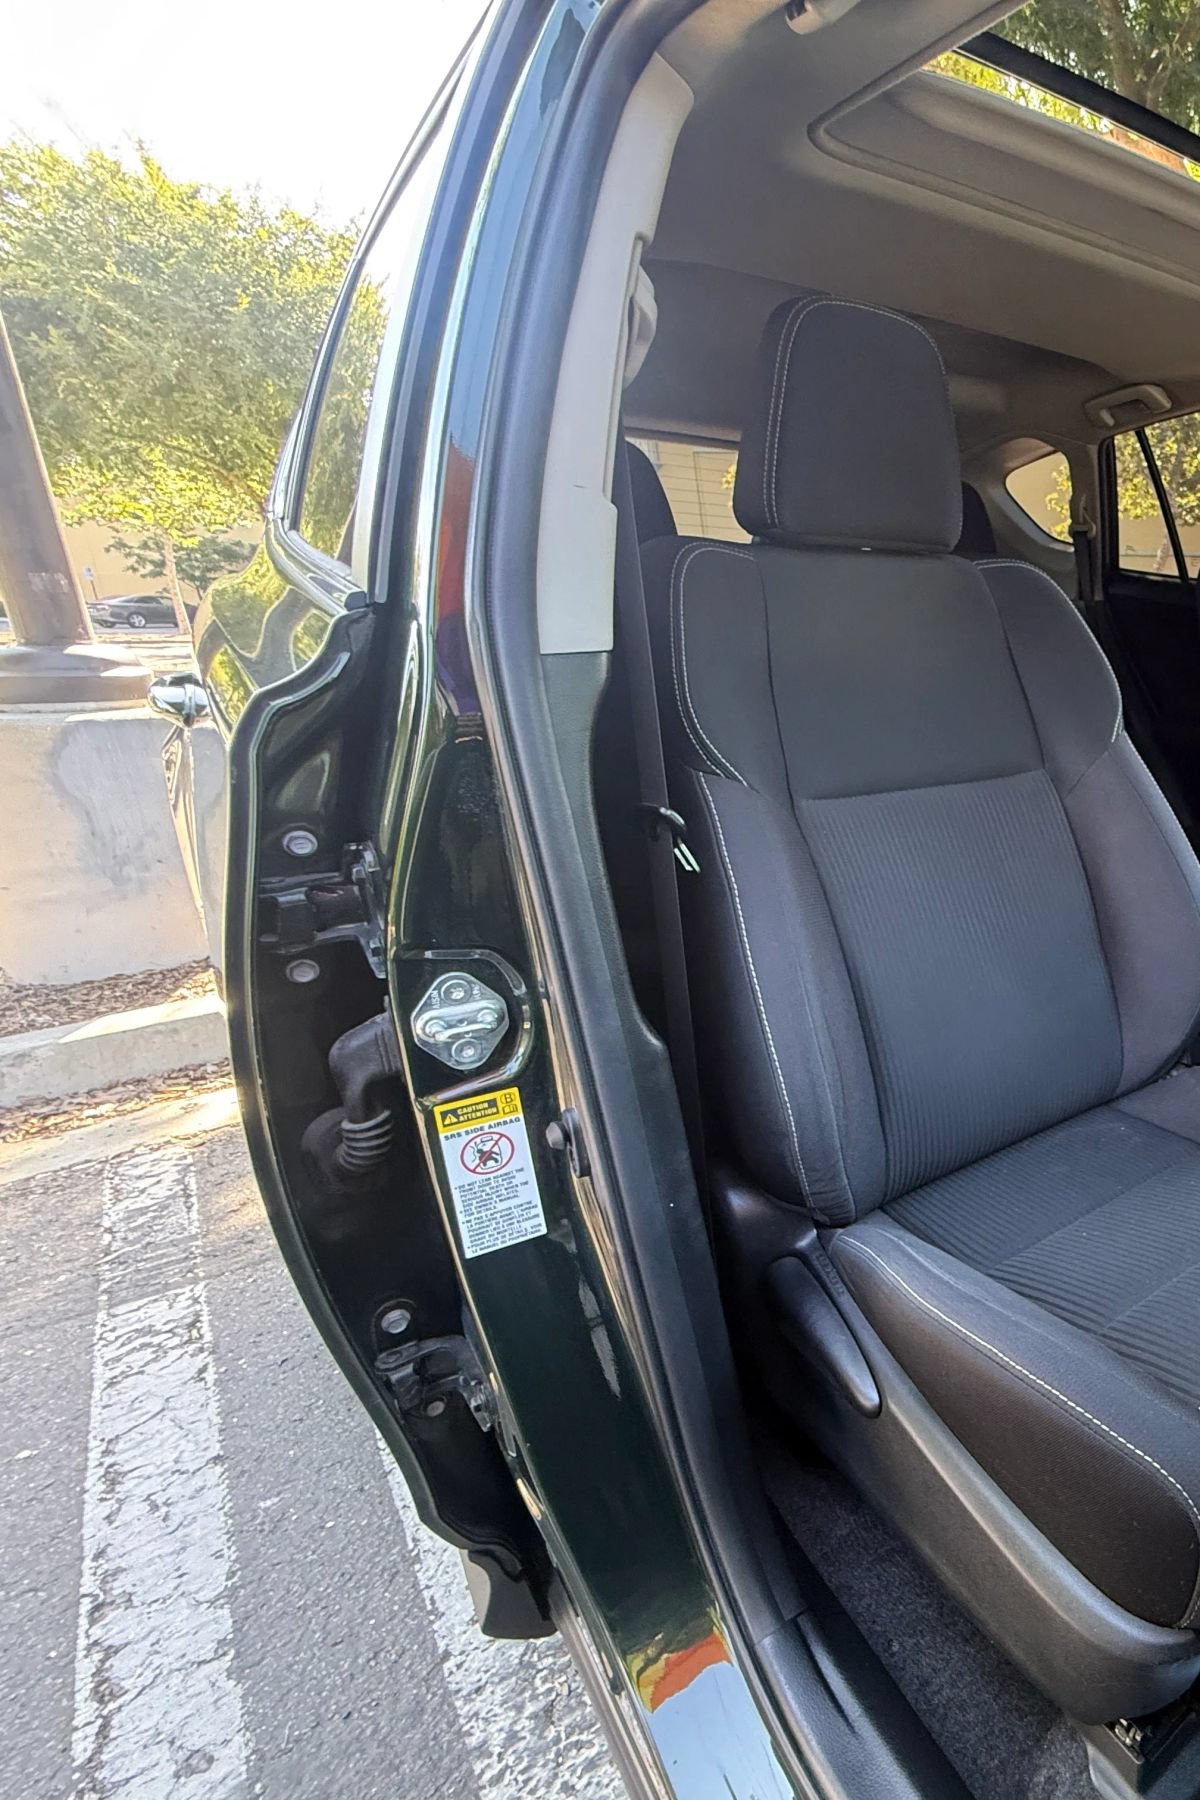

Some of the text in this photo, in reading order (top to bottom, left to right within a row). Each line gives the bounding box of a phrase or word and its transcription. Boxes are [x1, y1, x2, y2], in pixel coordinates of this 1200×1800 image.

[456, 1102, 488, 1114] CAUTION
[458, 1107, 497, 1122] ATTENTION
[443, 1116, 520, 1141] SRS SIDE AIRBAG
